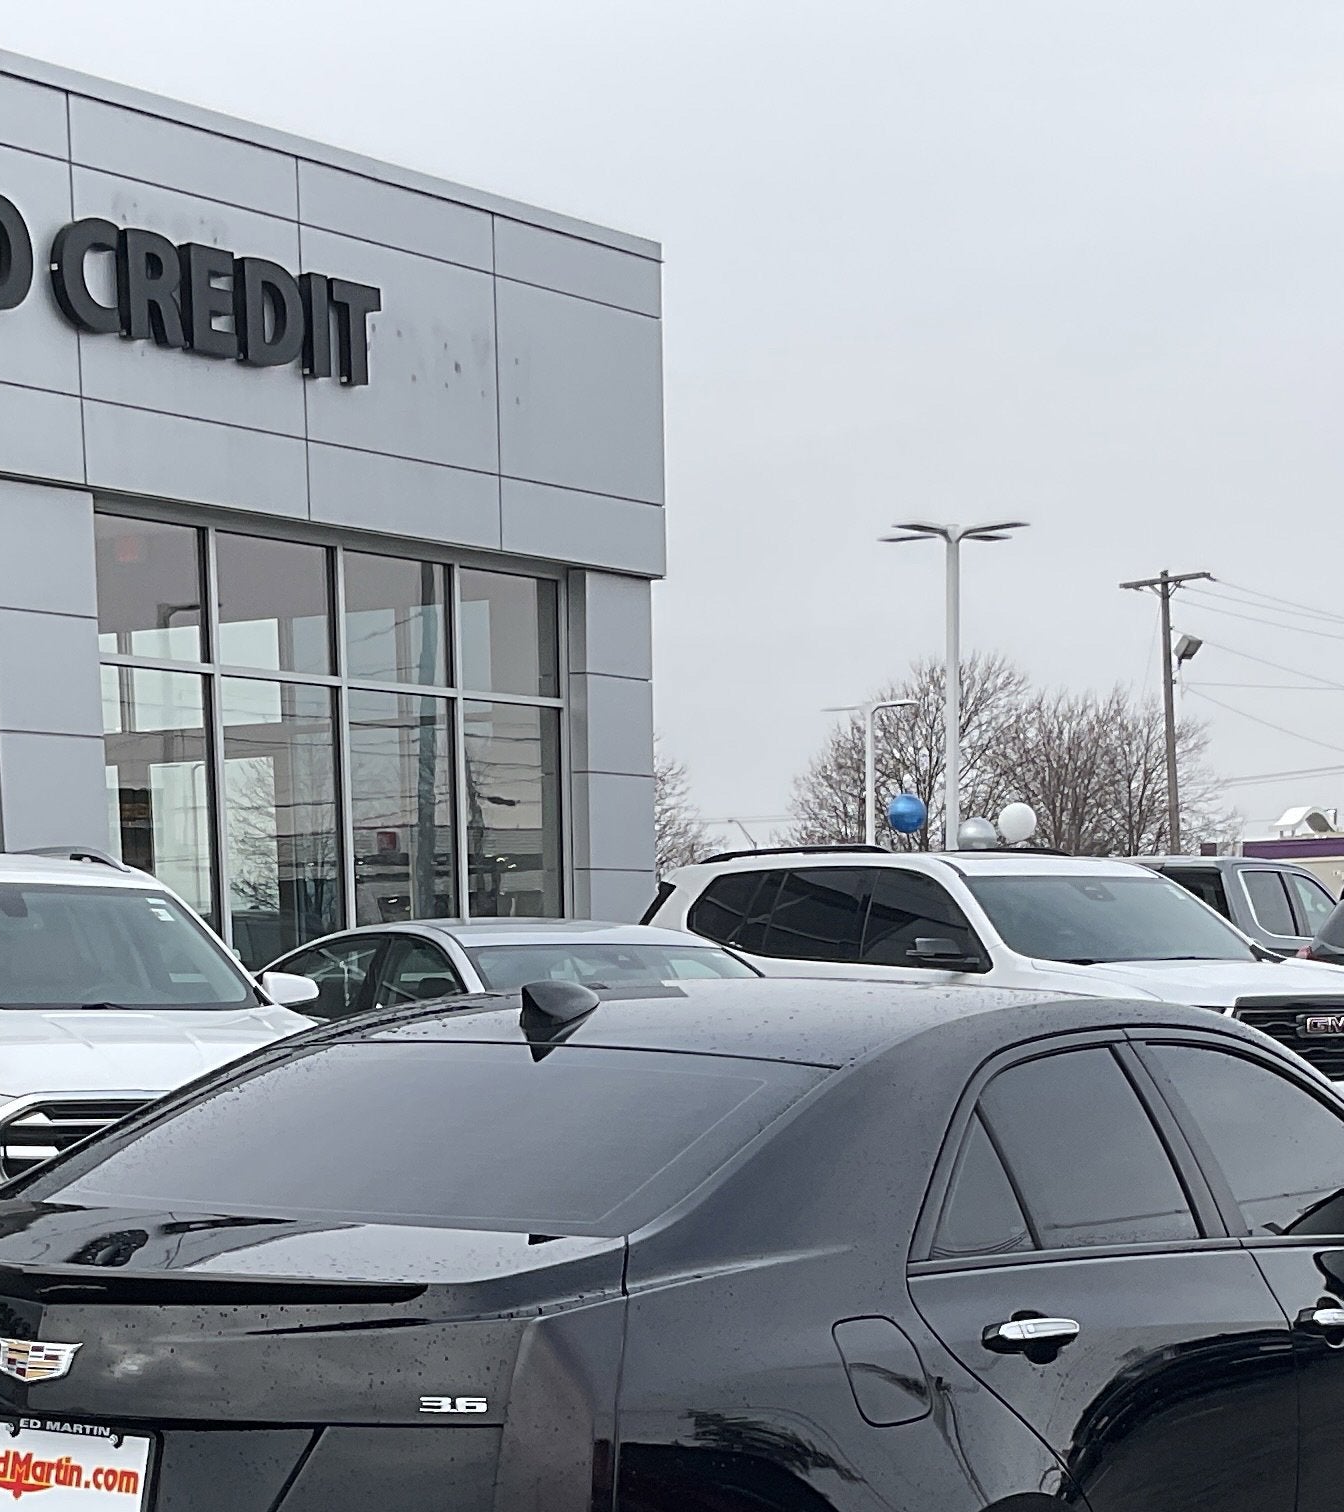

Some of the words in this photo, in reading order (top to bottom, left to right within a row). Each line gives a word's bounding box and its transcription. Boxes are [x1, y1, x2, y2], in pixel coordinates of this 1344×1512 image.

[49, 217, 382, 386] CREDIT
[419, 1396, 488, 1413] 3.6
[20, 1418, 42, 1430] ED
[46, 1421, 111, 1437] MARTIN
